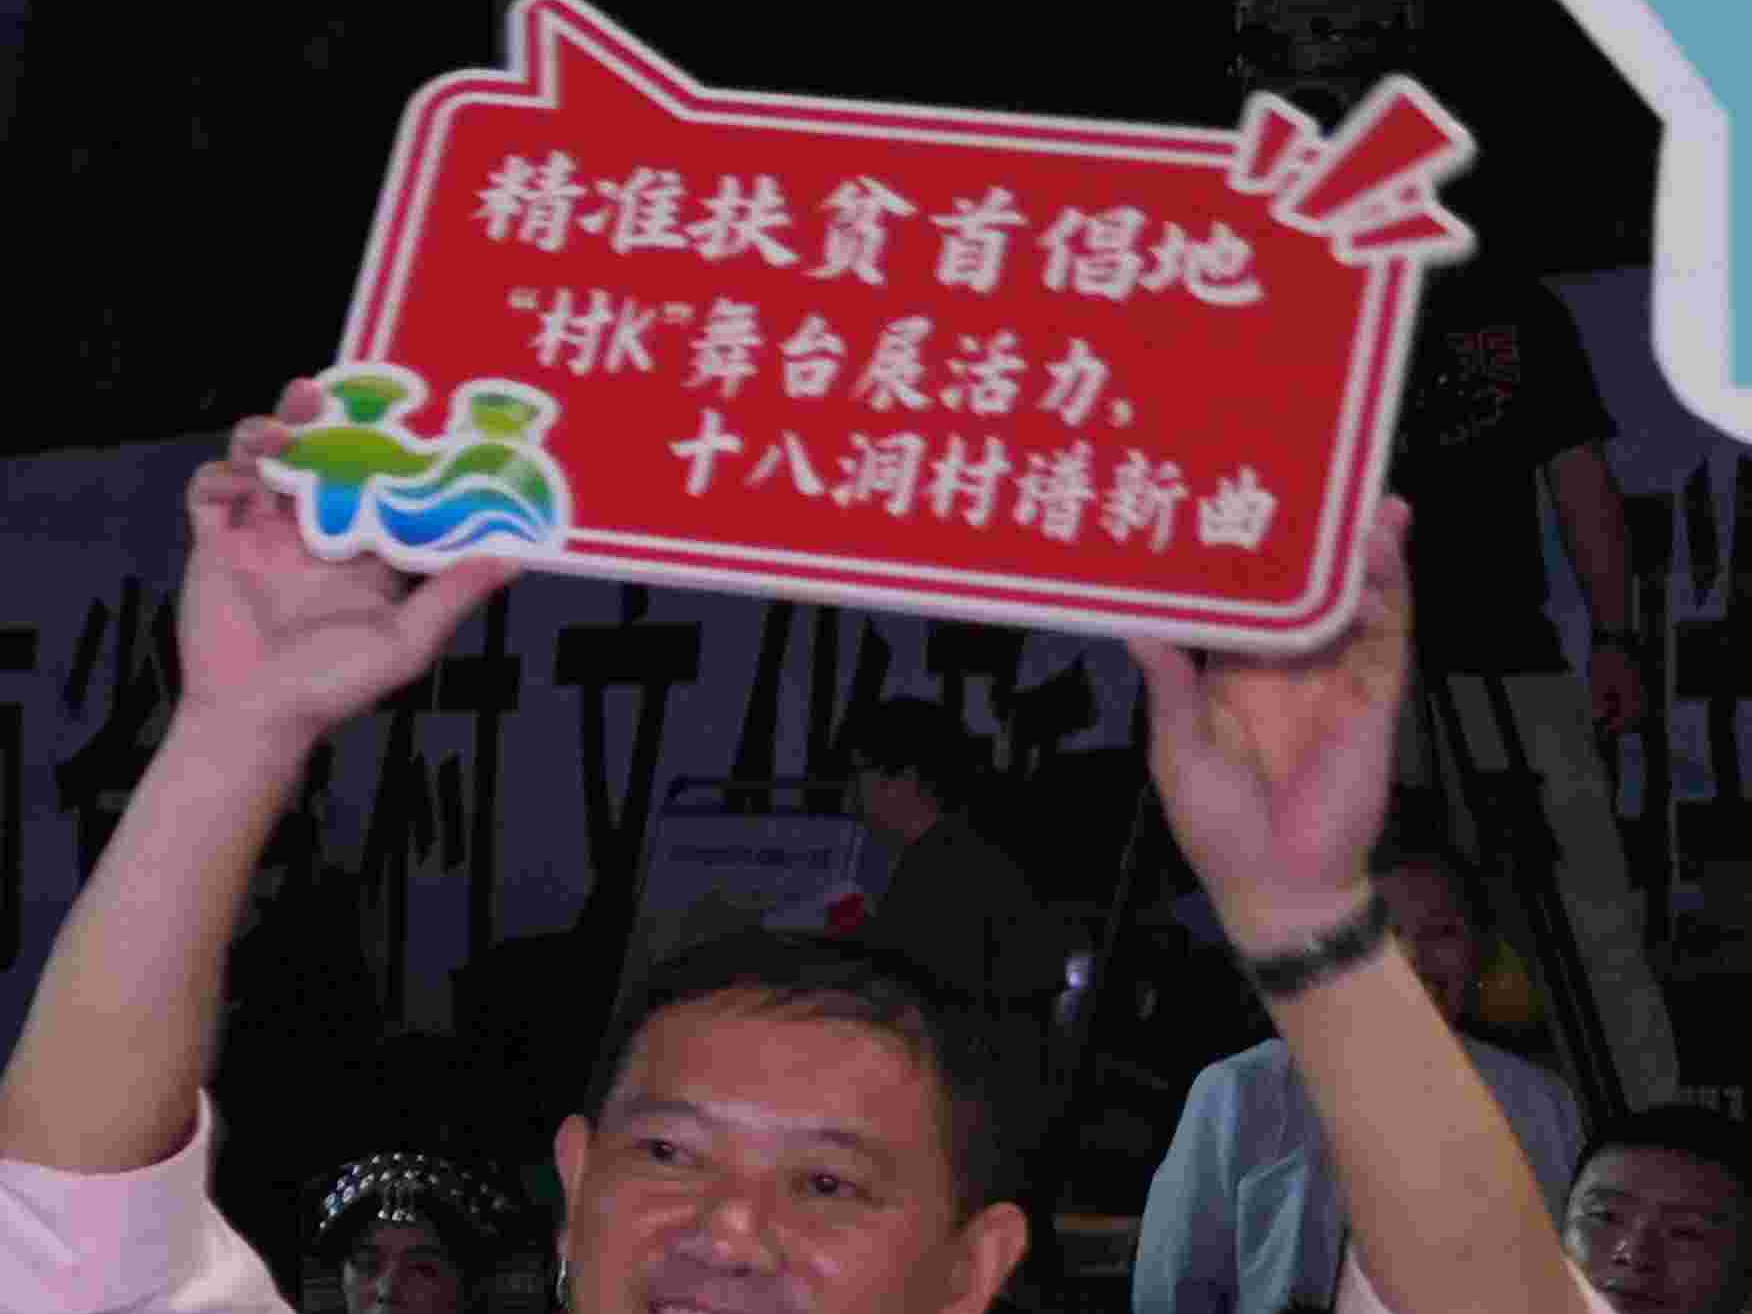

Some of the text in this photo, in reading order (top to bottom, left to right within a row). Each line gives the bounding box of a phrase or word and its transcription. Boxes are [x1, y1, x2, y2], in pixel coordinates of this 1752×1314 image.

[470, 148, 1264, 309] 精准扶贫首倡地
[670, 405, 1280, 555] 十八洞村谱新曲
